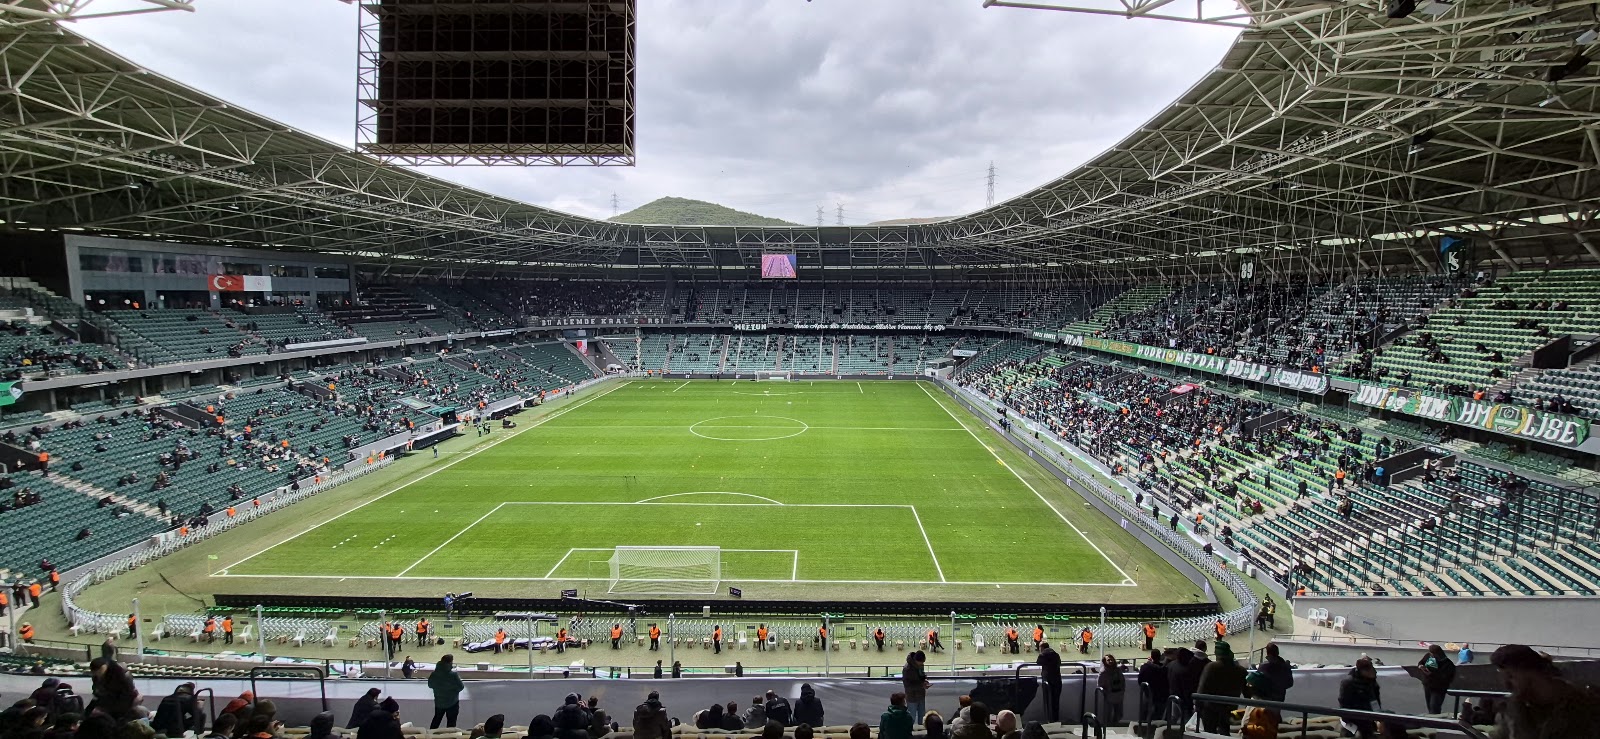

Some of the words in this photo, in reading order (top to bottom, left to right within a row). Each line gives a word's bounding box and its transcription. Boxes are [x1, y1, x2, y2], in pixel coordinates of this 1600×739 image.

[1241, 262, 1254, 279] 89
[556, 318, 596, 326] ALEMDE
[1175, 352, 1225, 373] MEYDAN
[1457, 400, 1493, 428] HM
